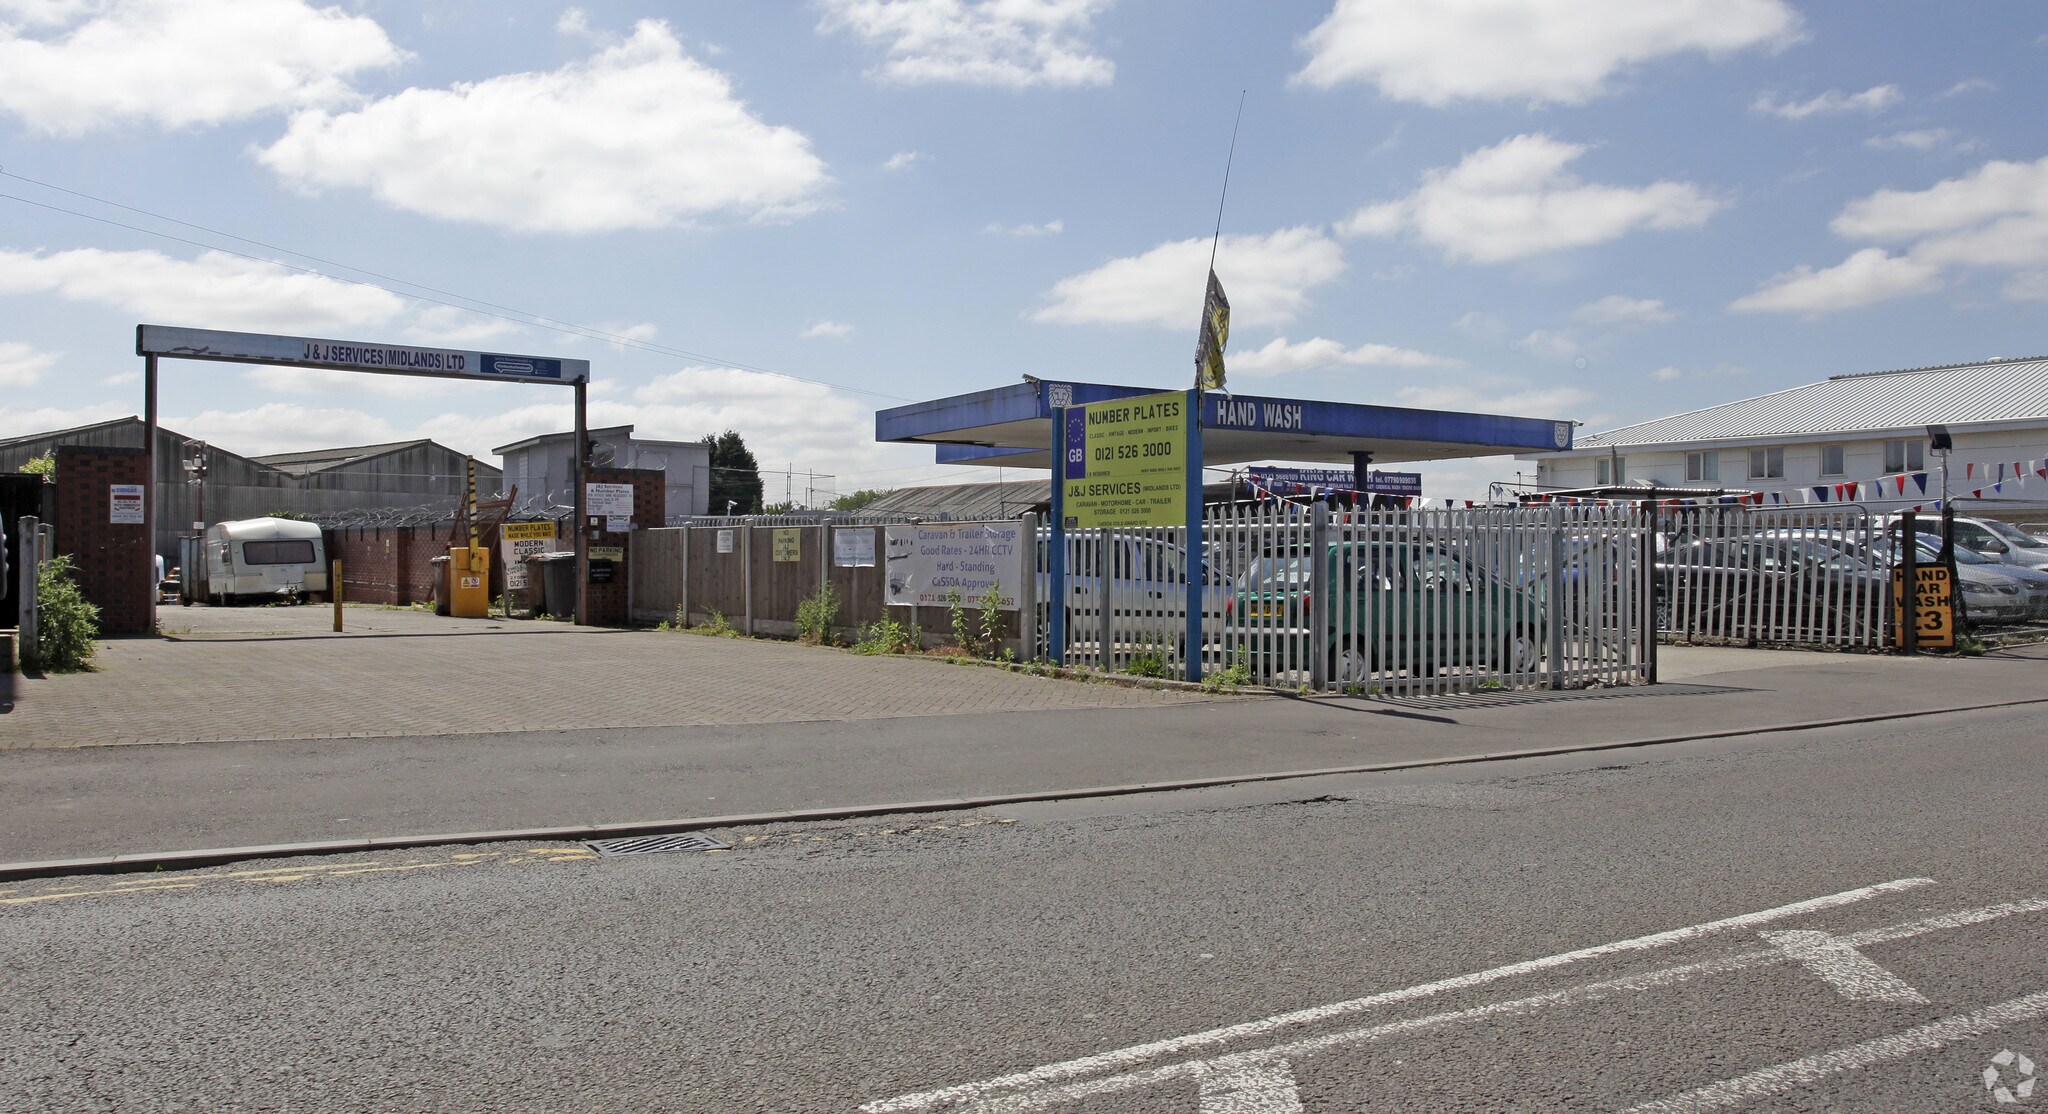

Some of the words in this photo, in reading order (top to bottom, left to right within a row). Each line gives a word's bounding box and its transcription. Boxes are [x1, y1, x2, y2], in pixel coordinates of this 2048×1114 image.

[304, 343, 310, 359] J
[313, 344, 320, 360] &
[323, 345, 329, 361] J
[332, 345, 384, 365] SERVICES
[384, 348, 444, 371] (MIDLANDS)
[446, 354, 465, 370] LTD
[1088, 407, 1130, 426] NUMBER
[1134, 402, 1180, 421] PLATES
[1217, 400, 1256, 426] HAND
[1263, 403, 1302, 430] WASH
[1068, 448, 1083, 463] GB
[1095, 446, 1114, 460] 0121
[1118, 444, 1138, 459] 526
[1142, 442, 1172, 457] 3000
[1300, 470, 1324, 481] KING
[1326, 471, 1346, 482] CAR
[1348, 471, 1373, 483] WH
[1068, 485, 1086, 497] J&J
[1089, 482, 1141, 496] SERVICES
[918, 530, 948, 540] Caravan
[950, 529, 956, 540] &
[958, 529, 984, 540] Trailer
[985, 529, 1016, 541] Storage
[514, 546, 544, 555] CLASSIC
[920, 544, 940, 556] Good
[942, 545, 962, 556] Rates
[969, 544, 989, 556] 24HR
[992, 544, 1014, 556] CCTV
[936, 562, 954, 571] Hard
[960, 562, 995, 575] Standing
